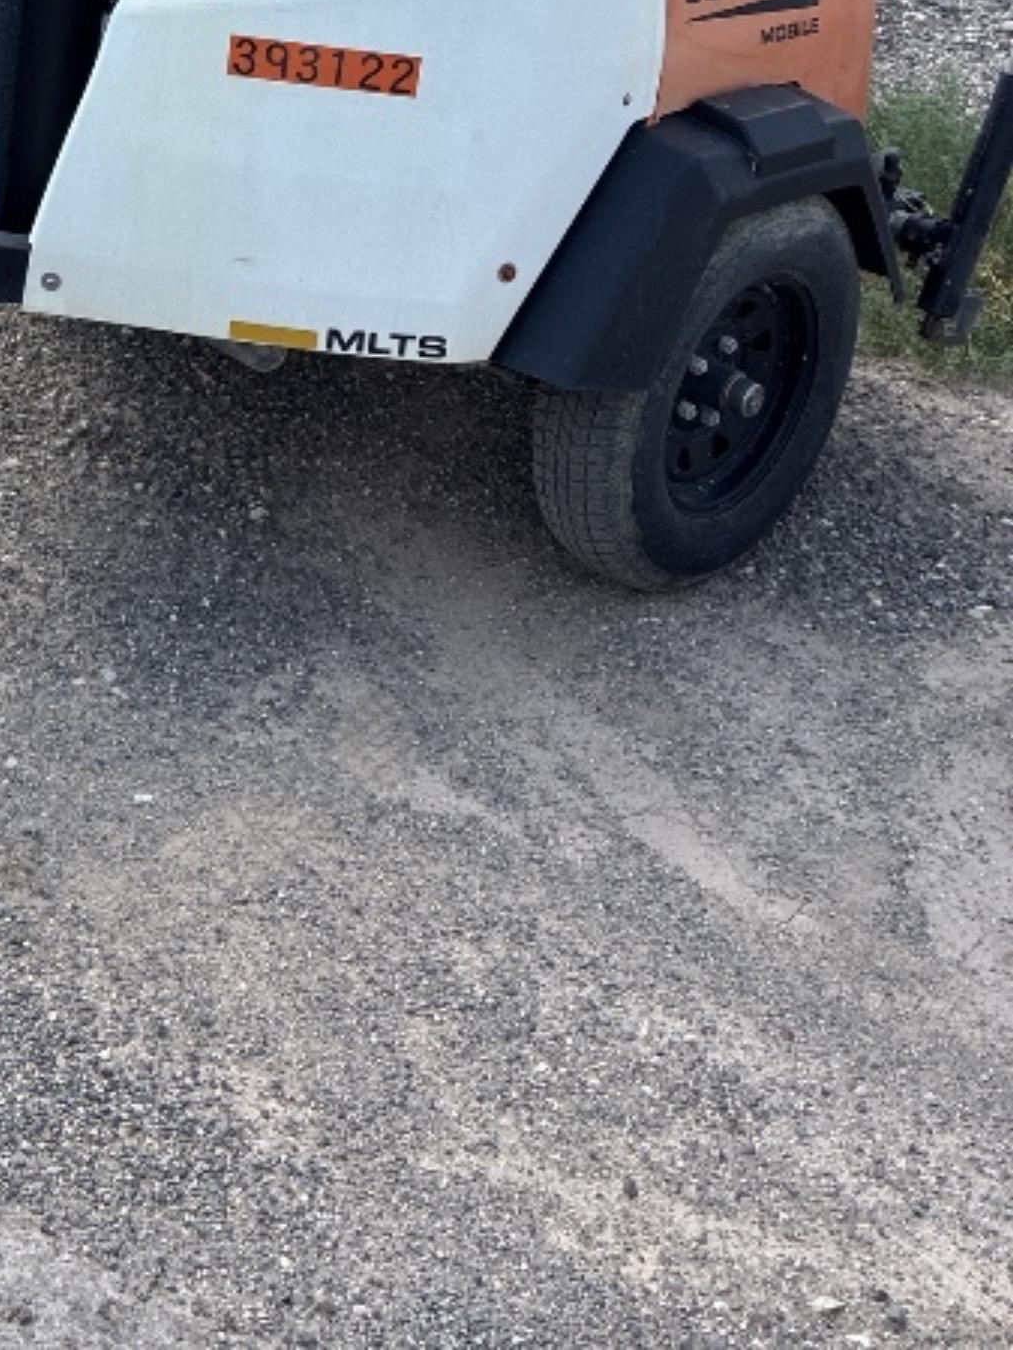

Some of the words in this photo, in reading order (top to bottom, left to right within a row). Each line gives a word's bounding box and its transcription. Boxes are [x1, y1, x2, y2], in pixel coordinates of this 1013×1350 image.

[760, 17, 820, 44] MOBILE
[231, 38, 417, 96] 393122
[325, 328, 448, 359] MLTS
